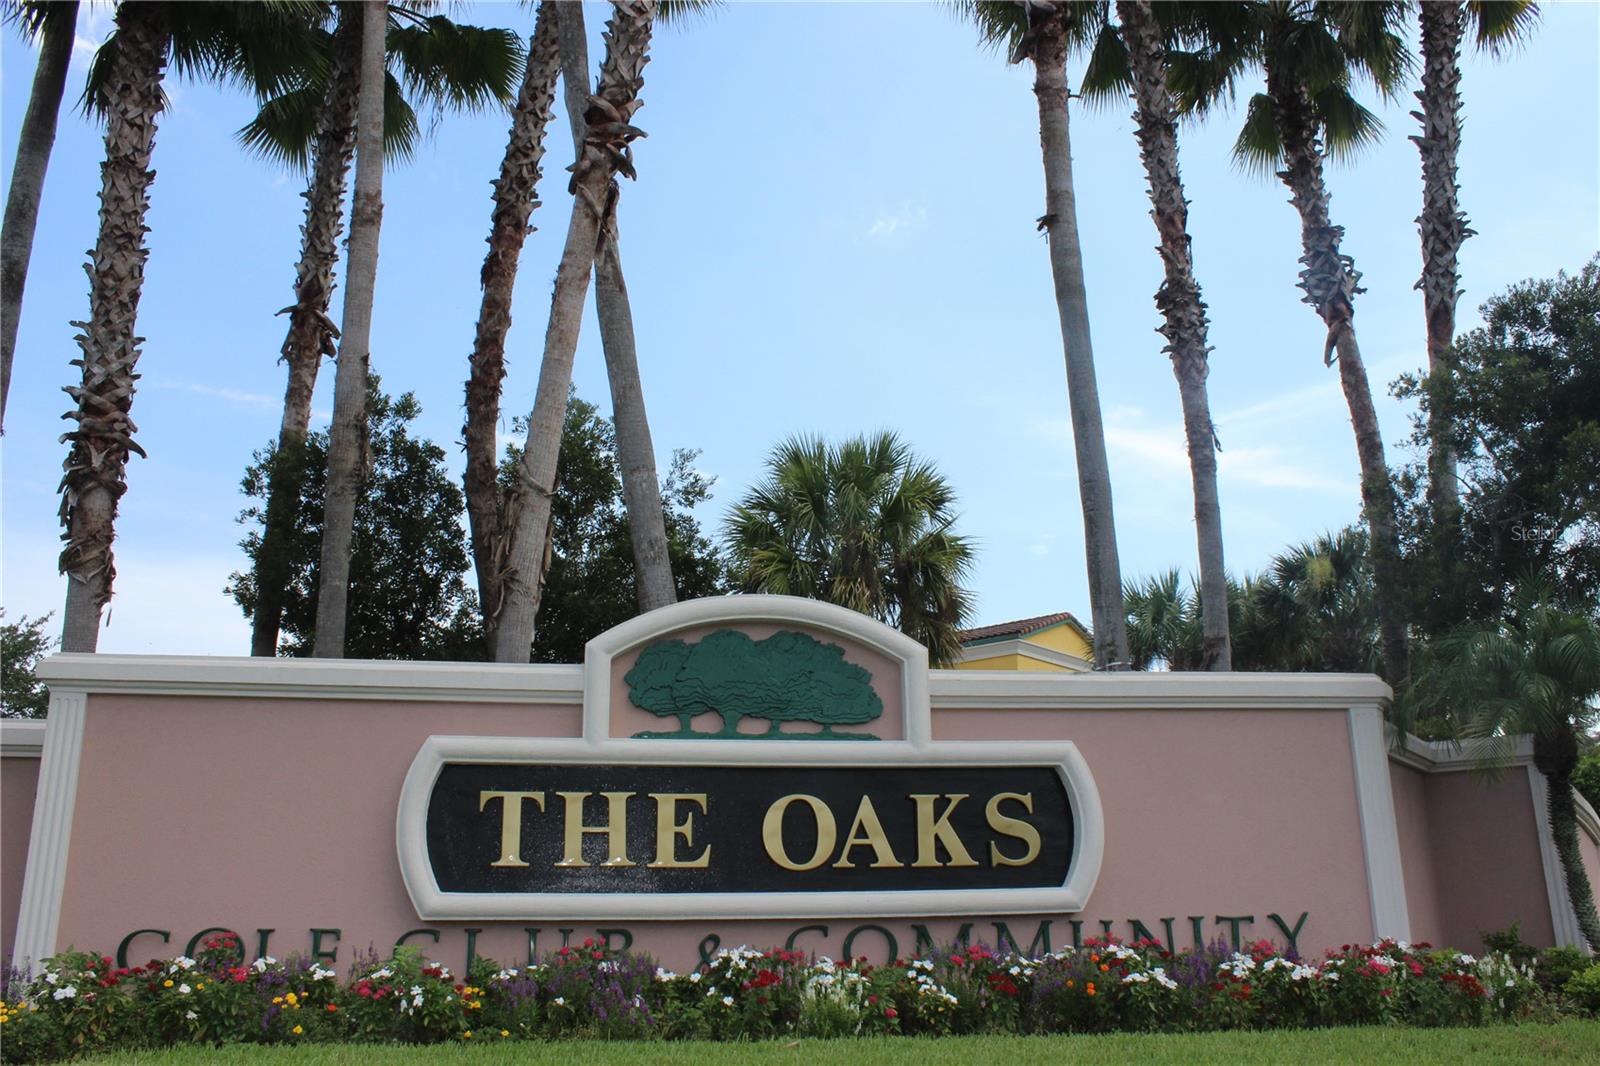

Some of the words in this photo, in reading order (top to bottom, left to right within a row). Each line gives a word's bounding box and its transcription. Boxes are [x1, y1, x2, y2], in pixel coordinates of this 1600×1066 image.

[479, 790, 712, 869] THE
[761, 791, 1042, 871] OAKS
[694, 933, 721, 976] &
